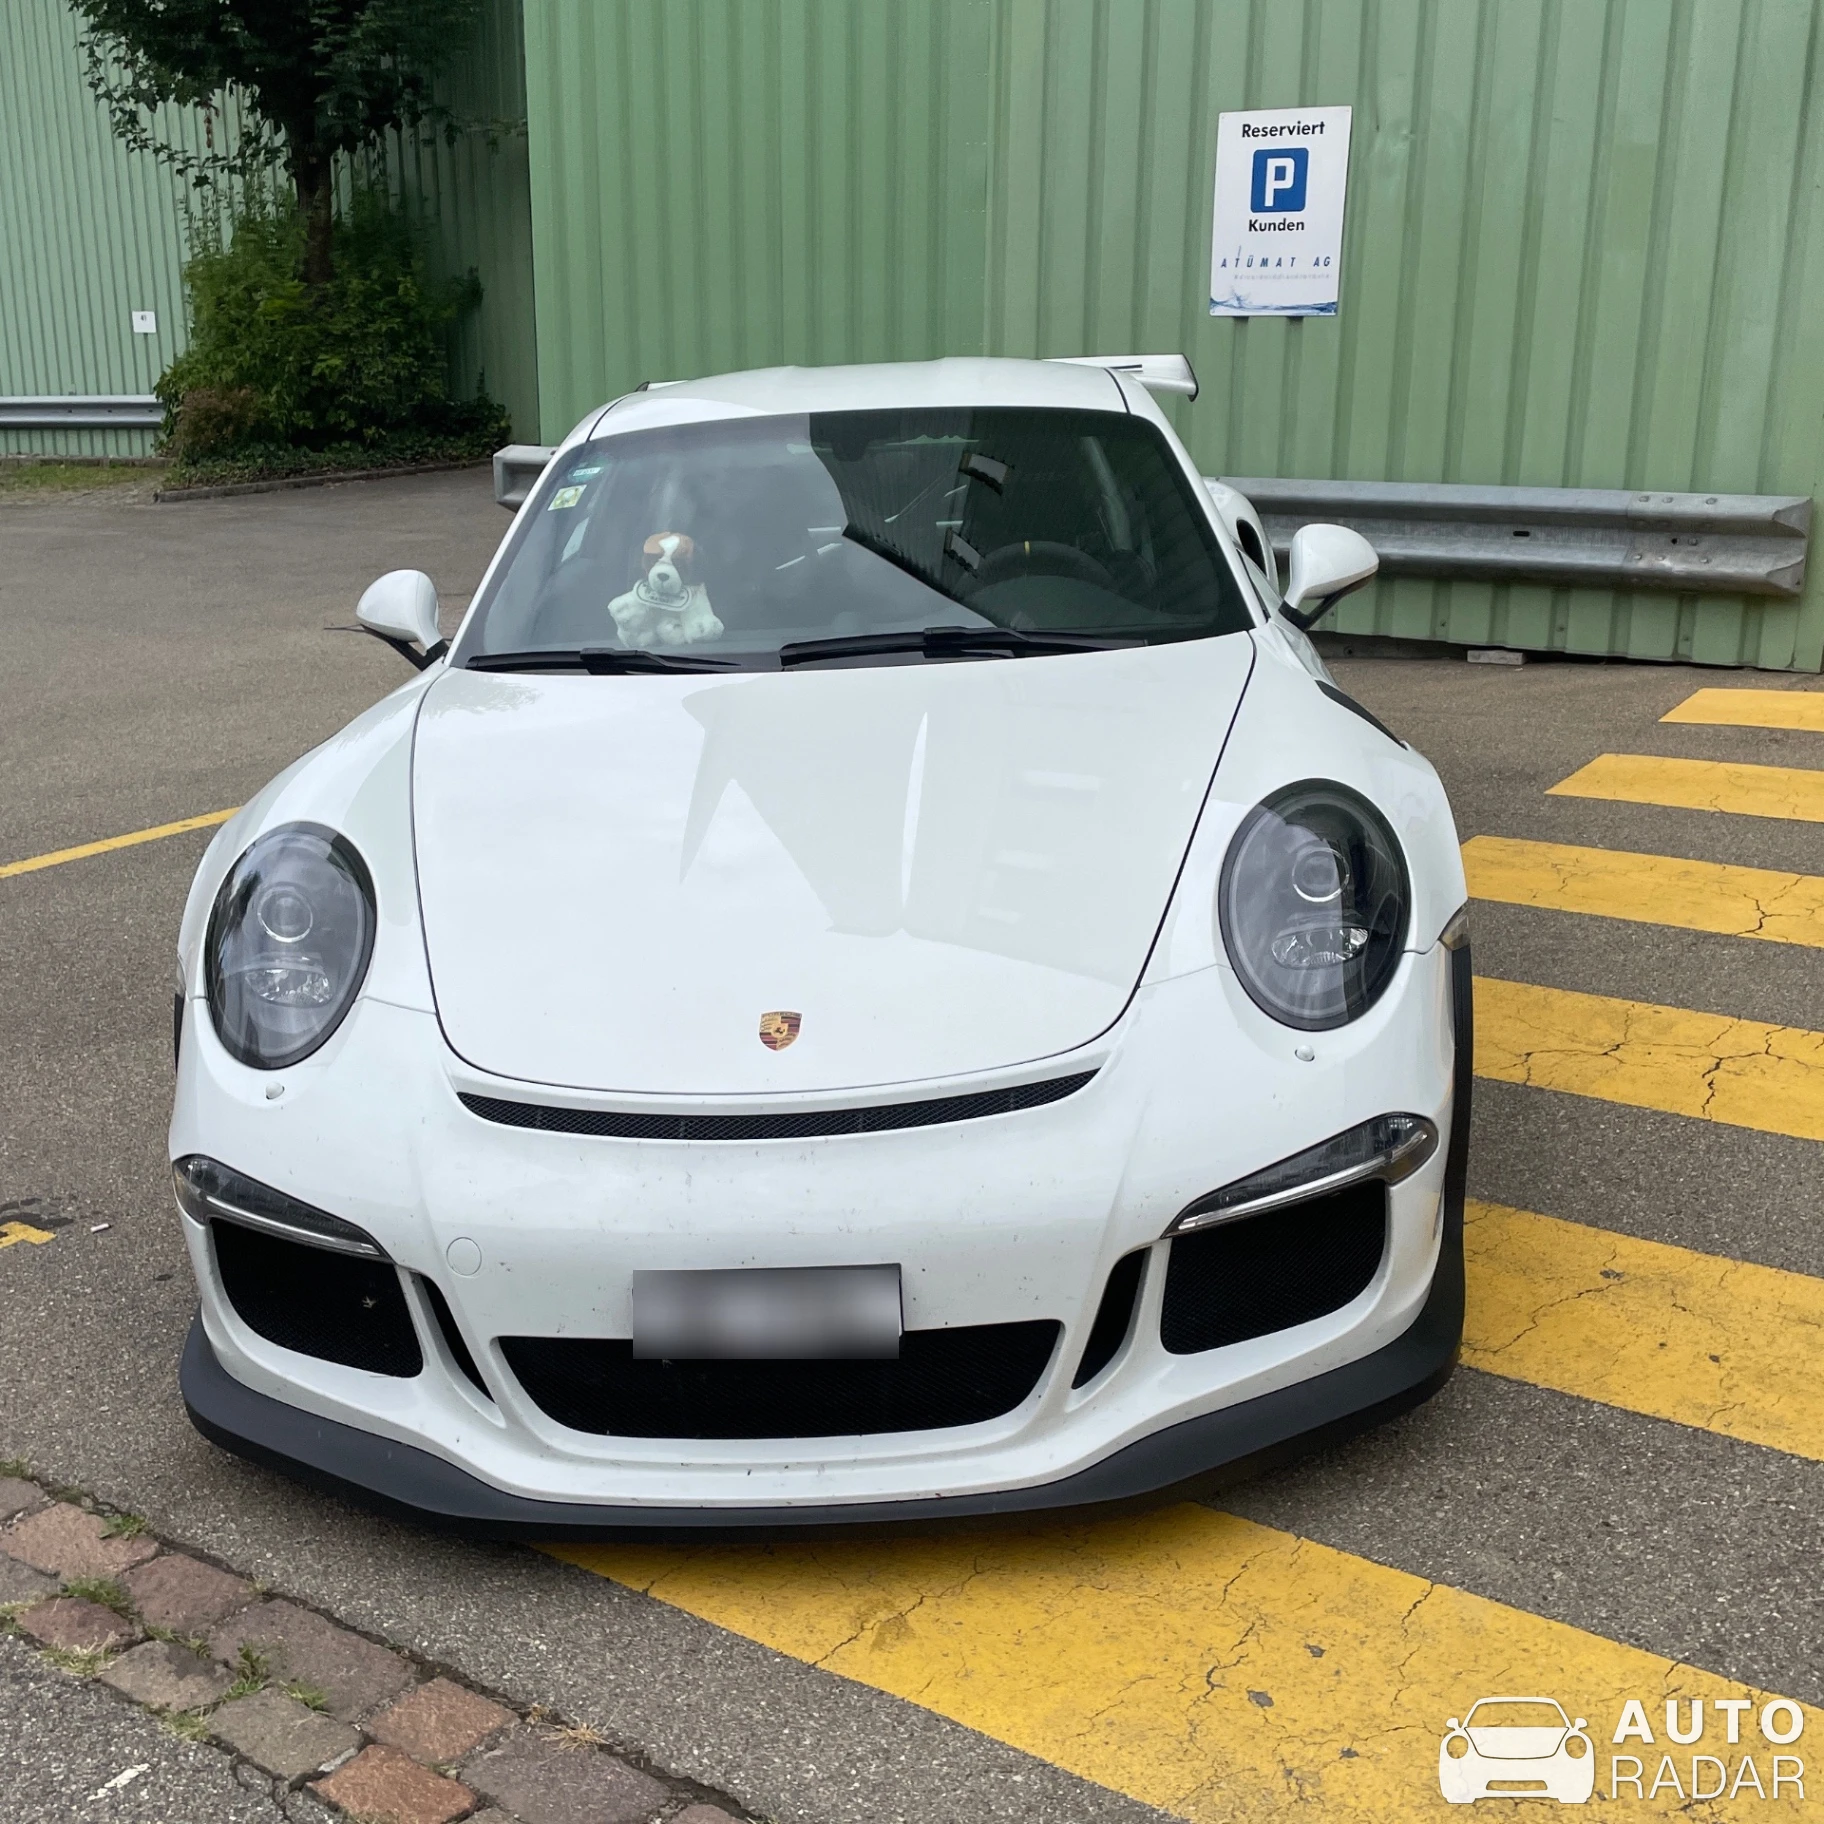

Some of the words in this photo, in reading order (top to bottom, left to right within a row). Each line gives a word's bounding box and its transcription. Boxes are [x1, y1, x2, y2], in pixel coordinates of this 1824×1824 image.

[1242, 121, 1325, 138] Reserviert
[1264, 157, 1295, 207] P
[1248, 218, 1305, 232] Kunden
[1313, 256, 1331, 267] AG
